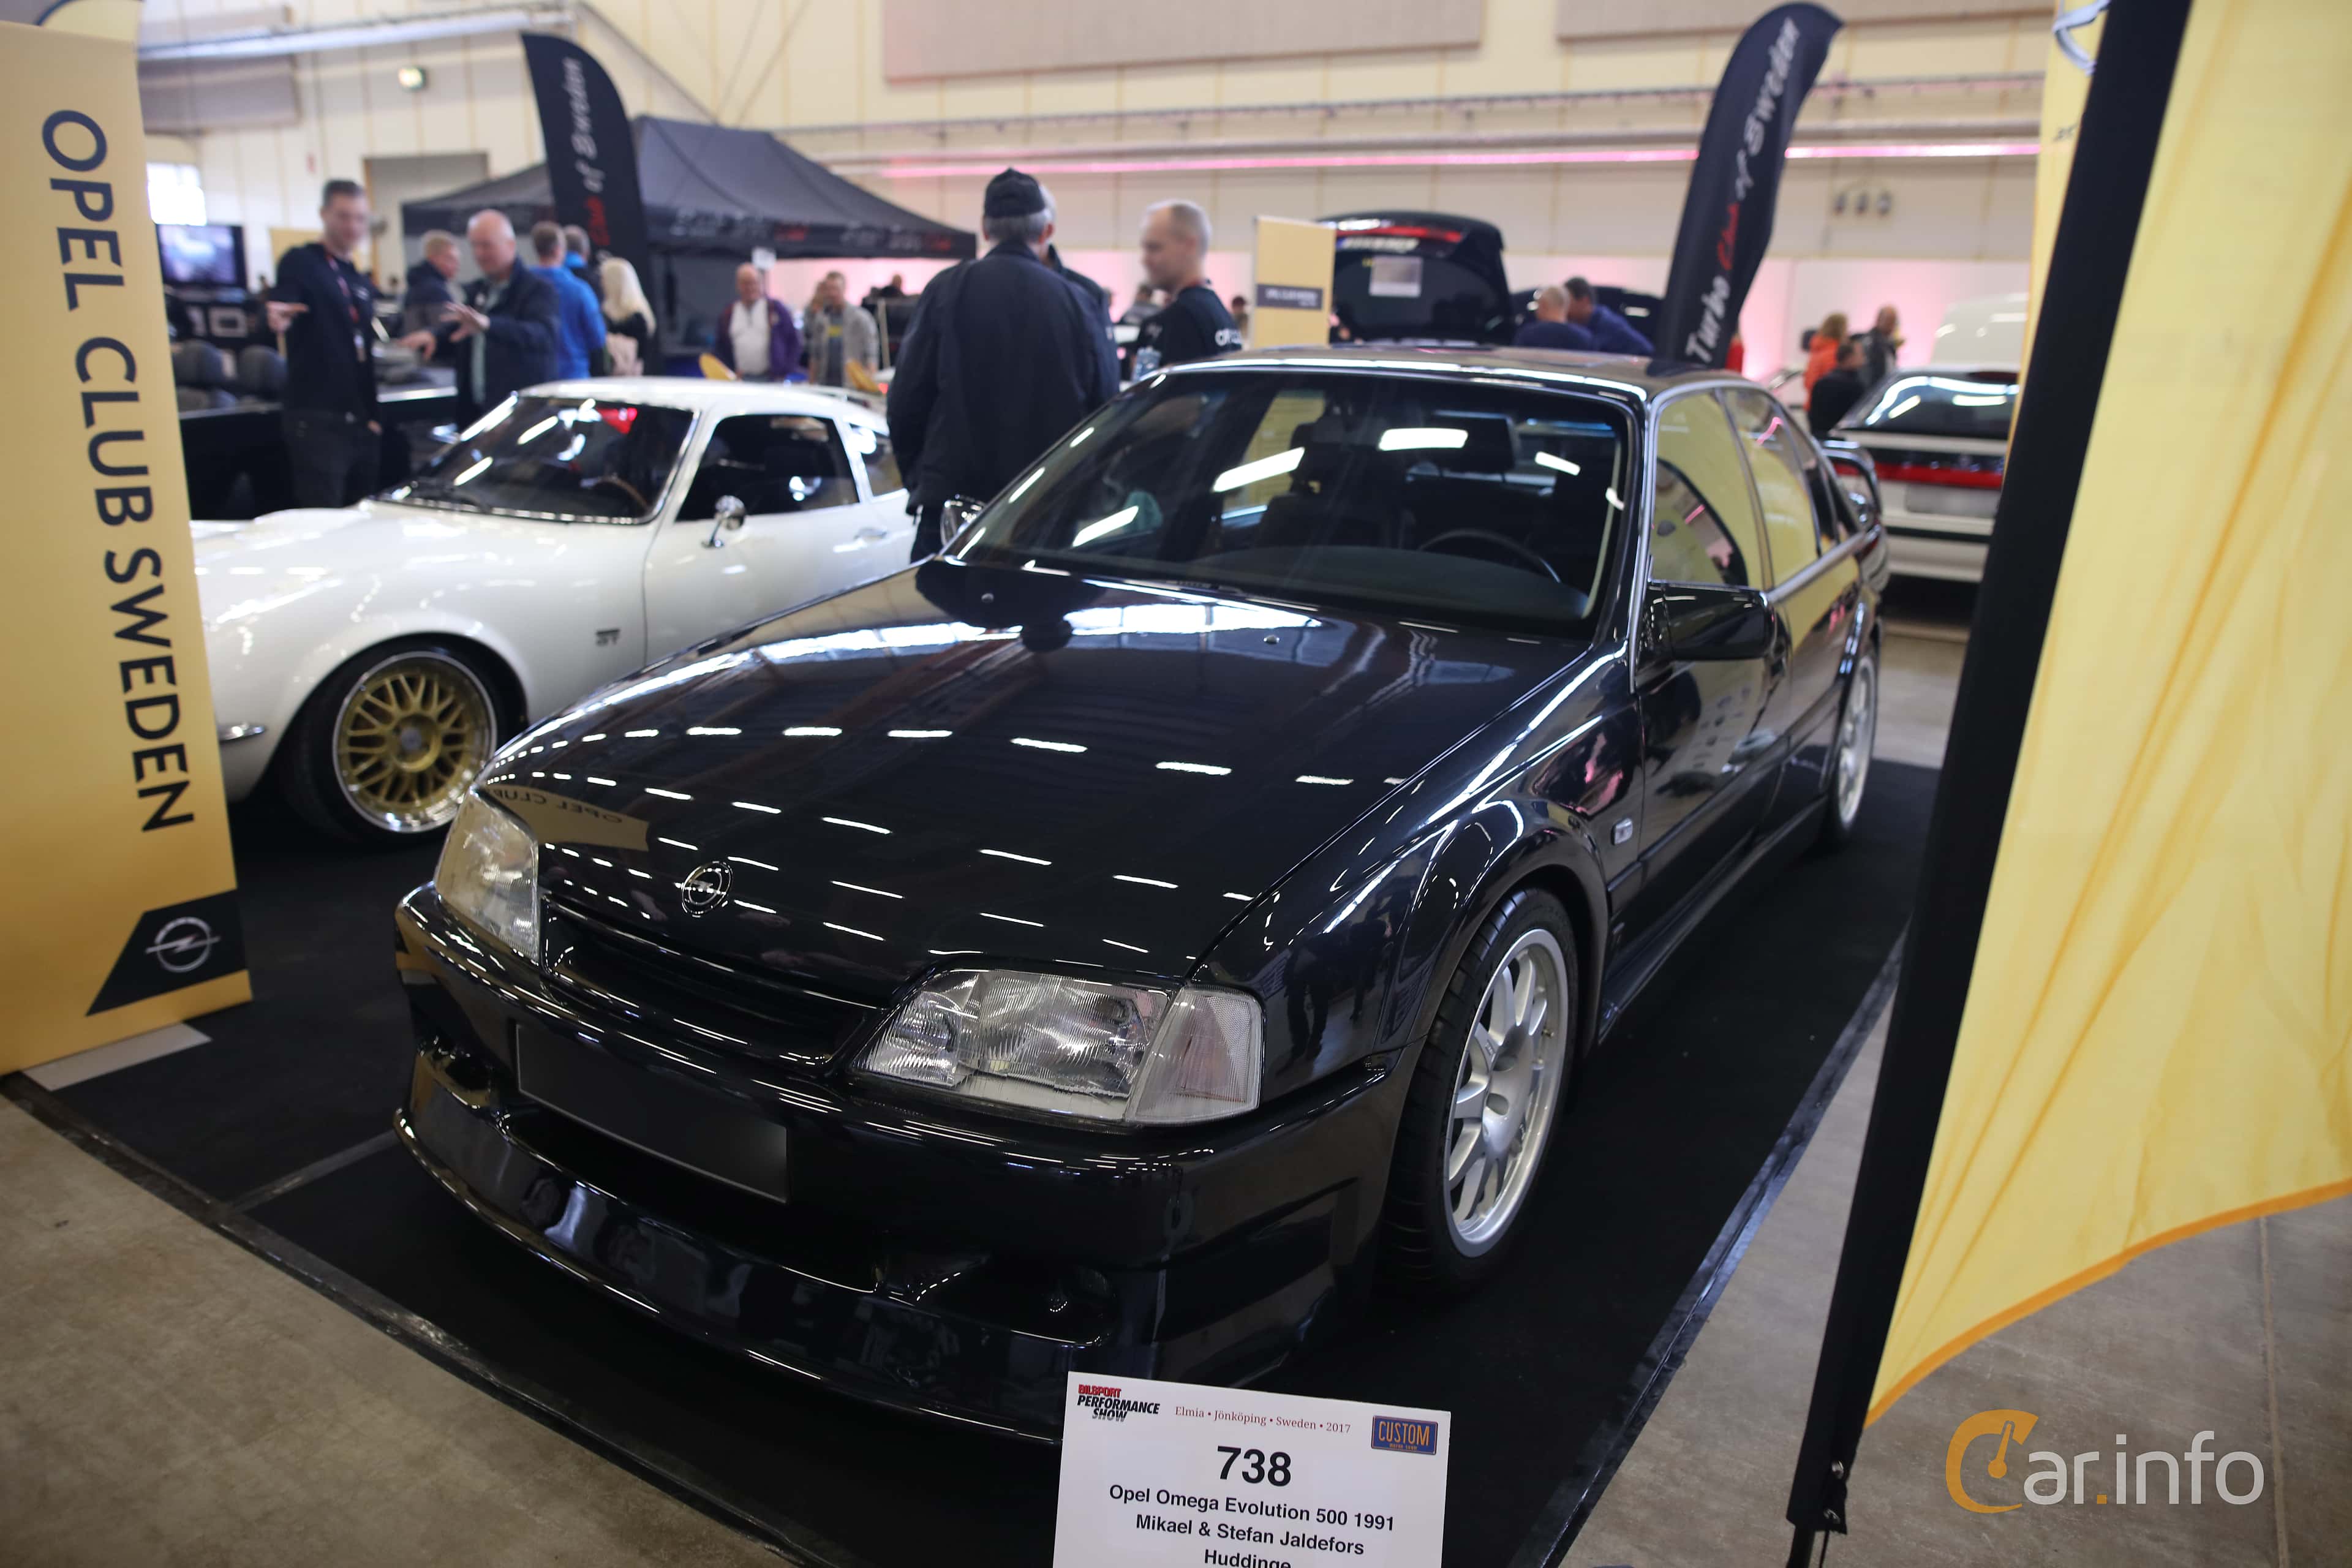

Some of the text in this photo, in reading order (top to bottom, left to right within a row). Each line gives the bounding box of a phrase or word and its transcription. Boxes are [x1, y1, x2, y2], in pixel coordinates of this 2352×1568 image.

[1685, 275, 1730, 364] Turbo
[1744, 17, 1801, 158] Sweden
[42, 110, 195, 832] OPEL CLUB SWEDEN
[1077, 1395, 1160, 1414] PERFORMANCE
[1078, 1384, 1121, 1398] BILSPORT
[1092, 1408, 1128, 1422] SHOW
[1175, 1406, 1351, 1433] Elmia Jönköping Sweden 2017
[1379, 1420, 1430, 1446] CUSTOM
[1217, 1446, 1291, 1487] 738
[1109, 1484, 1394, 1531] Opel Omega Evolution 500 1991
[1136, 1513, 1365, 1555] Mikael & Stefan Jaldefors
